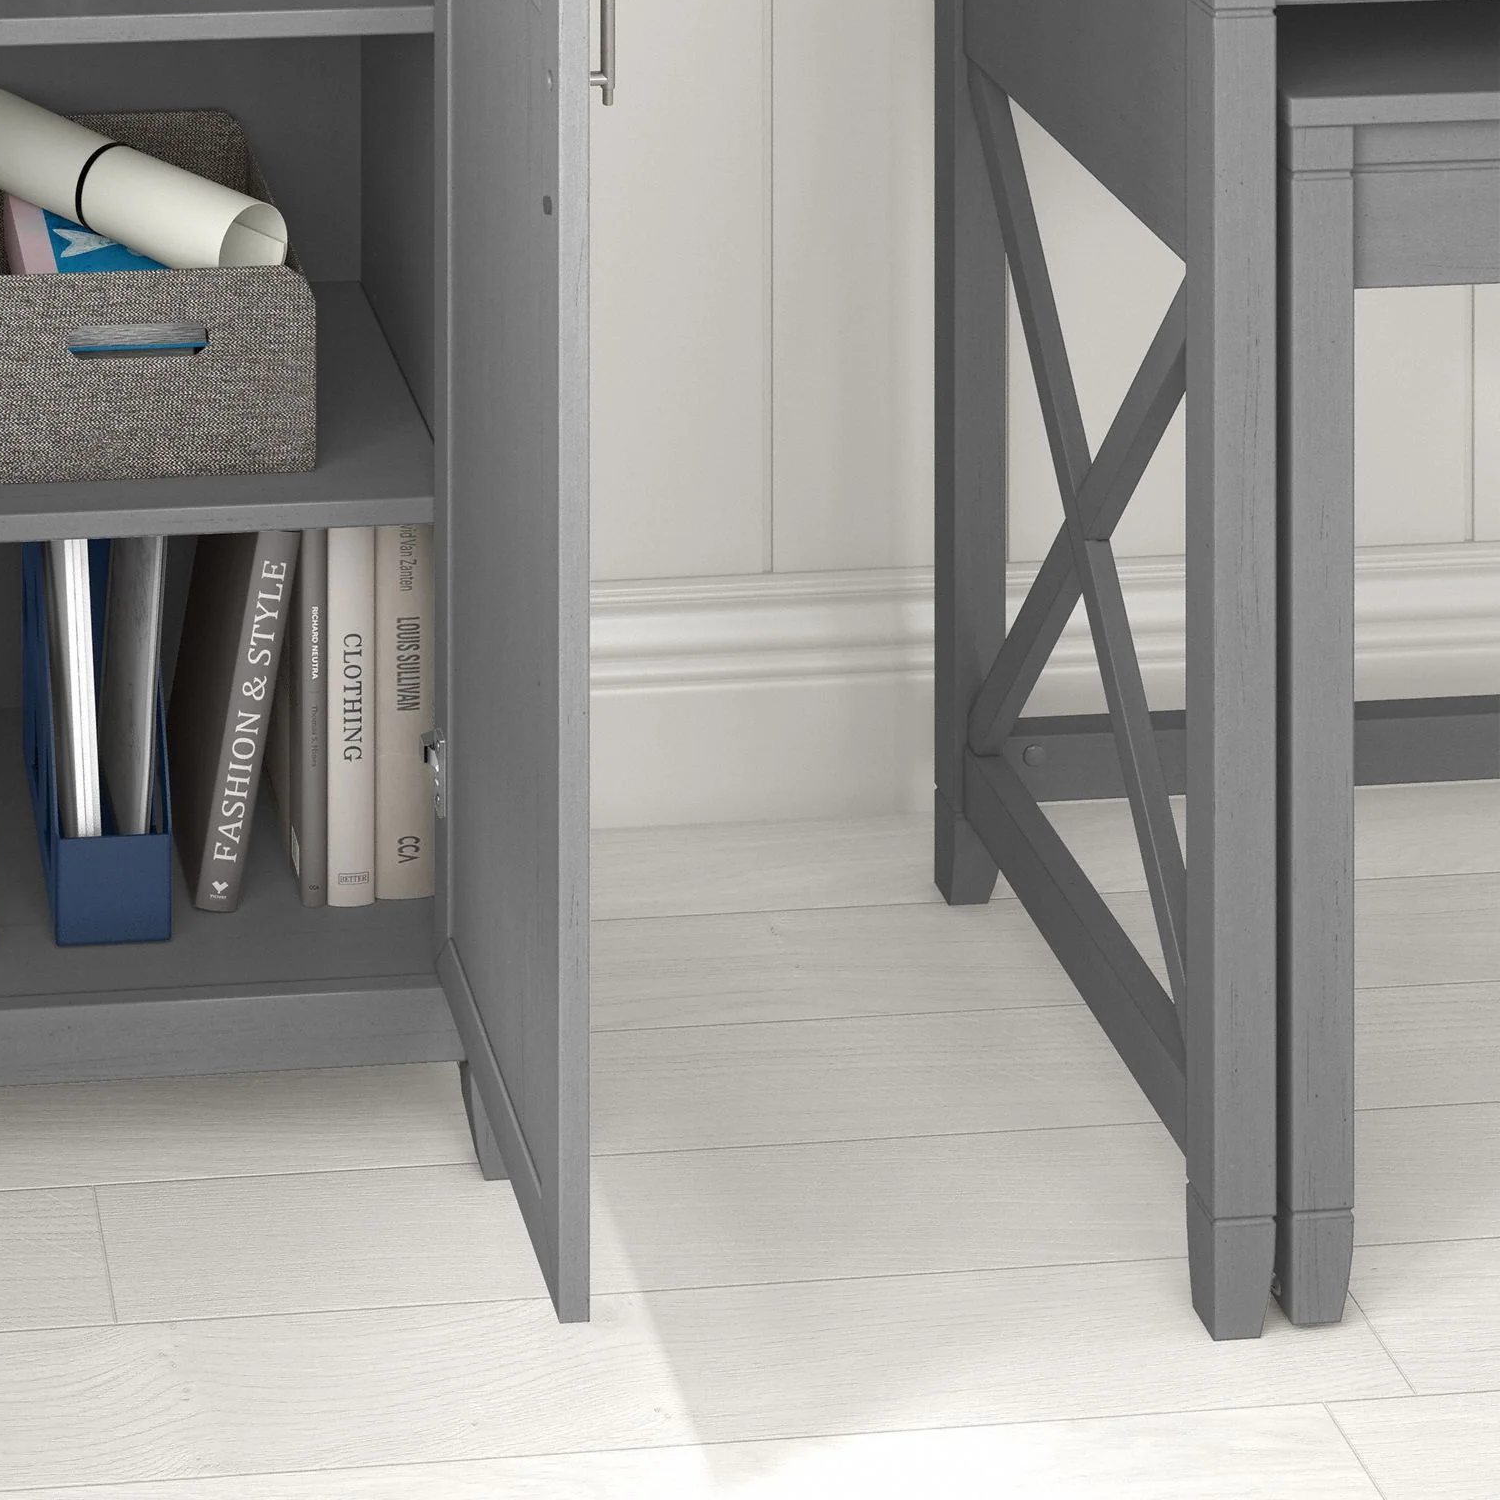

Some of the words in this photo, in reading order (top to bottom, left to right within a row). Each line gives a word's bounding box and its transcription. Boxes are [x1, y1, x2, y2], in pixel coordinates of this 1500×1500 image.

[400, 539, 417, 557] Van
[401, 559, 418, 591] Zanten
[248, 560, 287, 666] STYLE
[311, 606, 319, 643] RICHARD
[397, 616, 420, 651] LOUIS
[242, 675, 267, 701] &
[343, 633, 363, 762] CLOTHING
[397, 654, 420, 711] SULLIVAN
[213, 710, 261, 863] FASHION
[397, 835, 420, 864] CCA
[339, 875, 367, 883] BETTER
